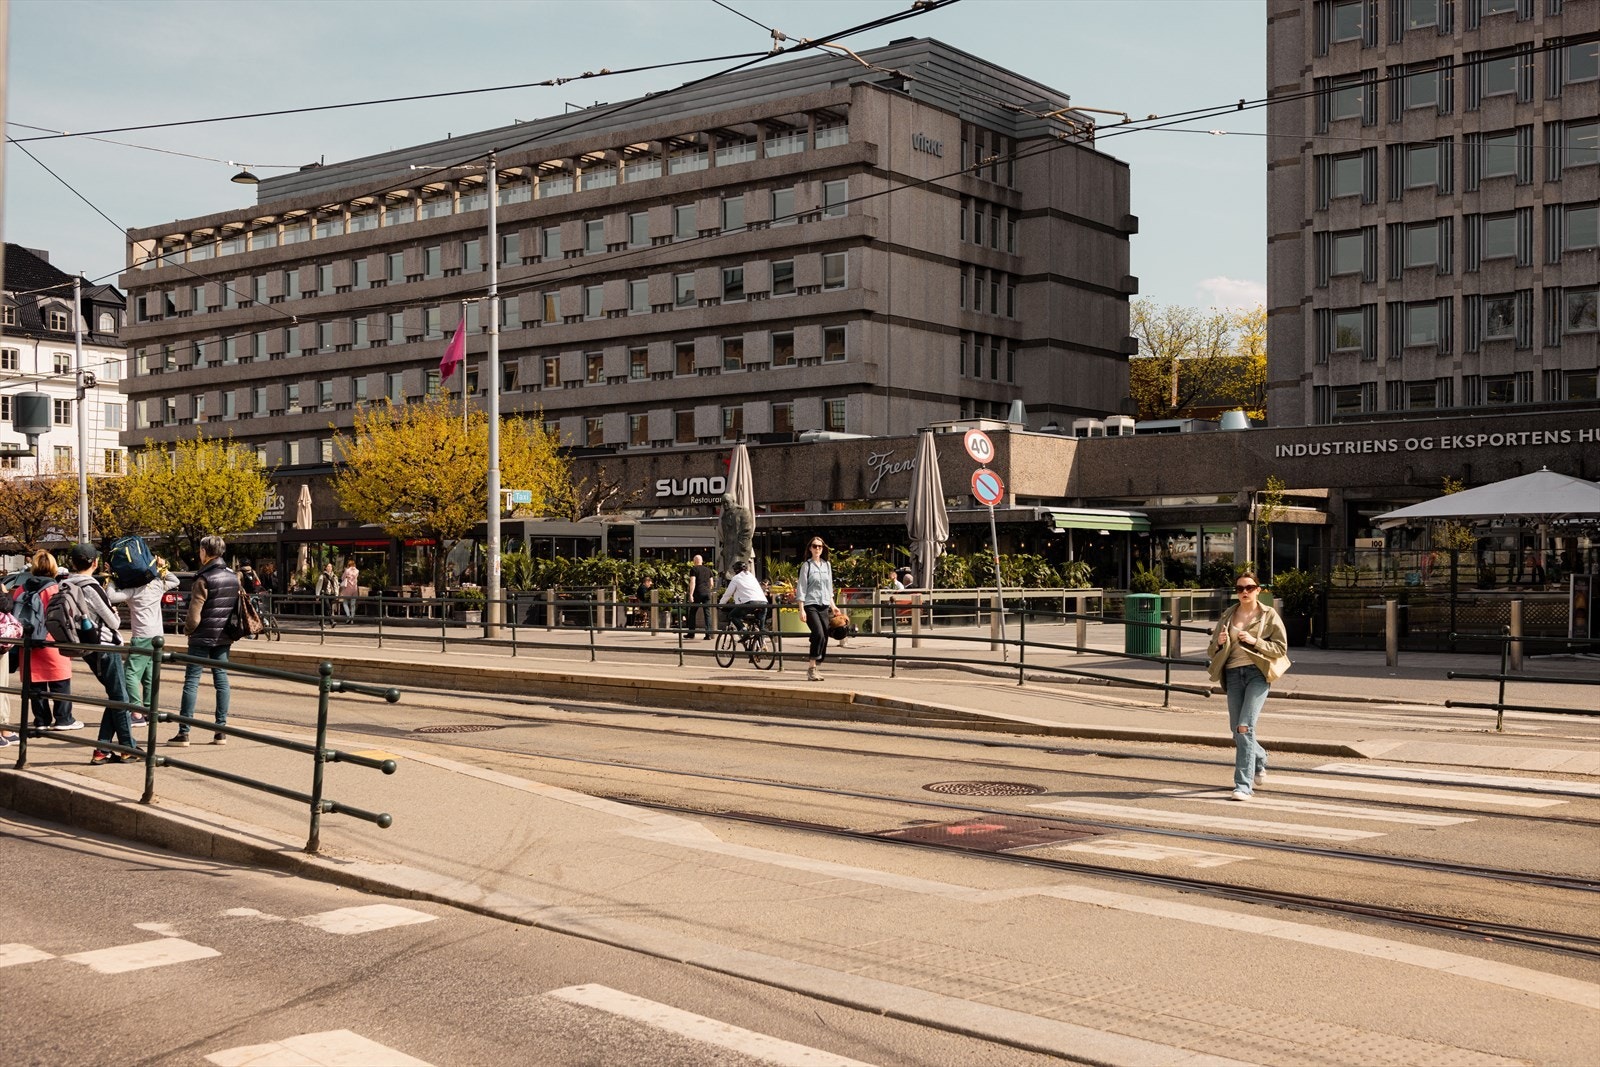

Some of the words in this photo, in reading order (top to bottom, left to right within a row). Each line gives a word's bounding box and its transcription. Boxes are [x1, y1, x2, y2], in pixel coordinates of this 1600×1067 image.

[912, 132, 944, 158] VIRKE
[971, 438, 989, 455] 40
[1275, 439, 1398, 457] INDUSTRIENS
[1404, 437, 1433, 451] OG
[1440, 430, 1572, 449] EKSPORTENS
[655, 476, 726, 497] SUMO
[516, 492, 529, 501] Taxi
[690, 496, 722, 504] Restaura
[1371, 540, 1383, 548] 100
